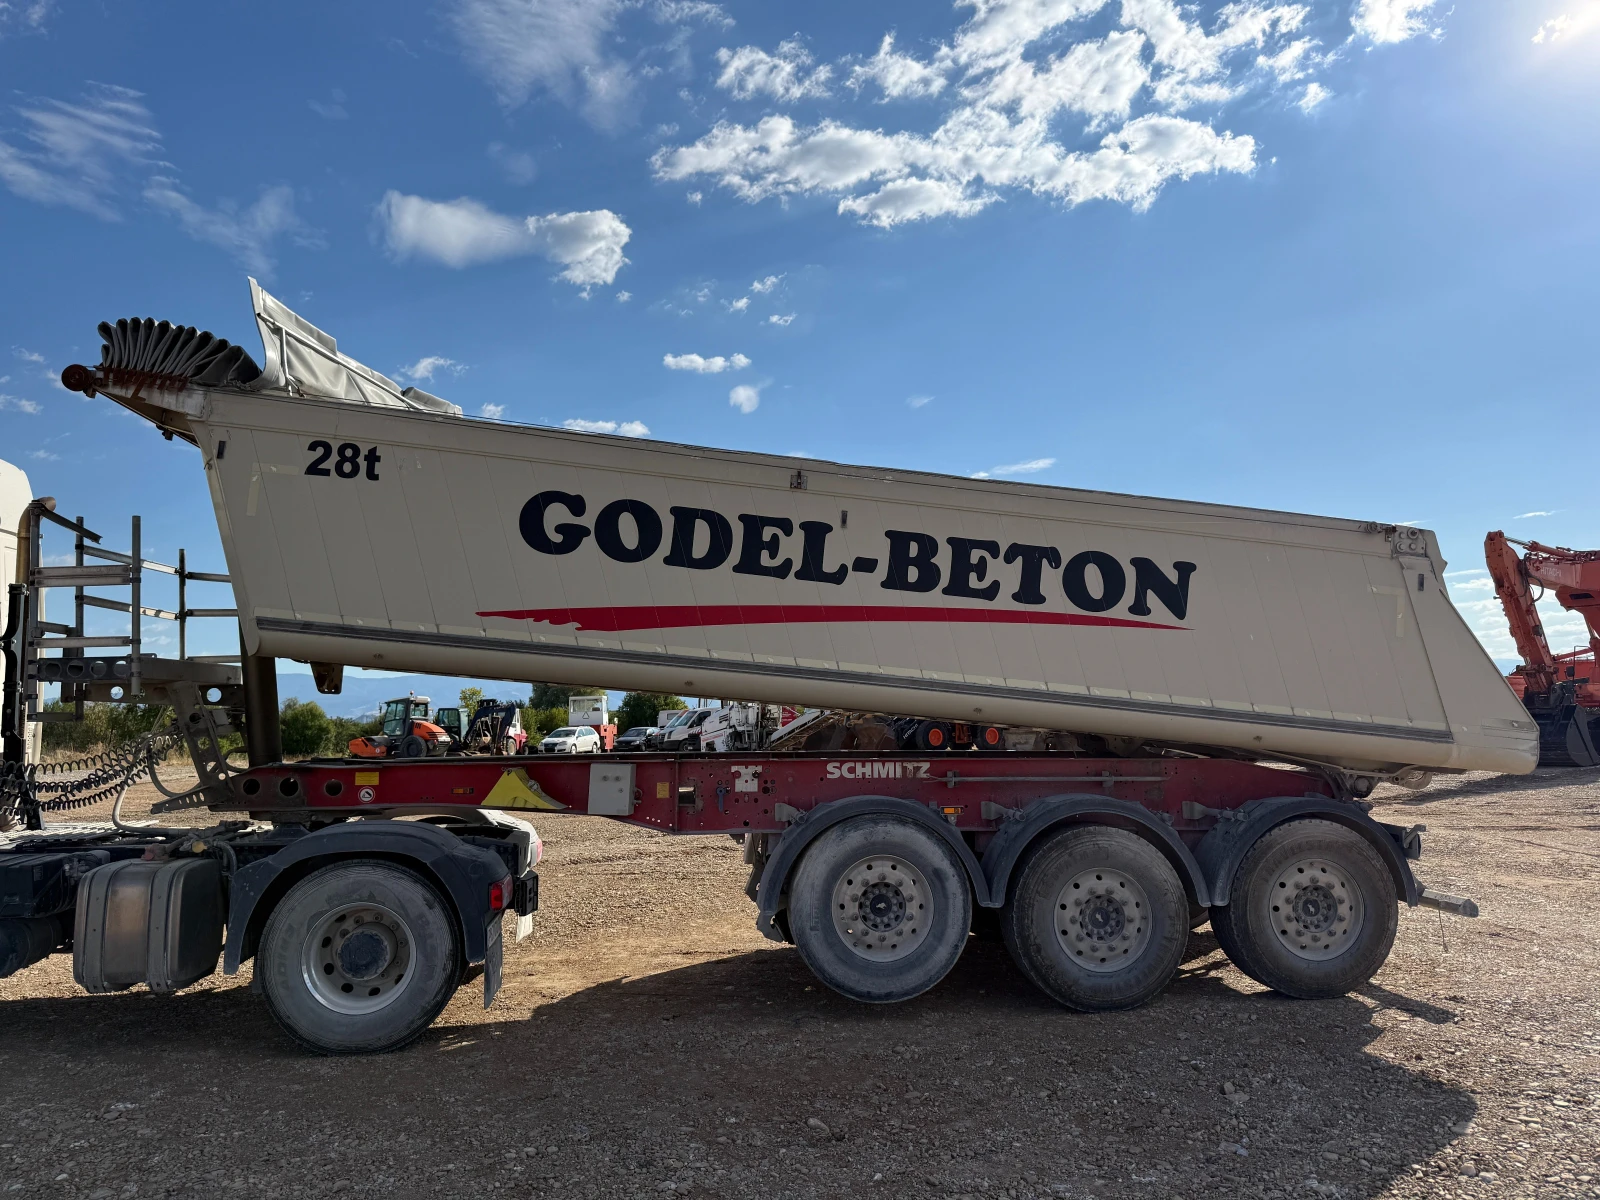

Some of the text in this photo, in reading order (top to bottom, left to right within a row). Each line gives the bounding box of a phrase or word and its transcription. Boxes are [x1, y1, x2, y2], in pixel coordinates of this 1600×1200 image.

[304, 440, 381, 481] 28t
[518, 490, 1197, 621] GODEL-BETON
[1540, 566, 1562, 577] HITACHI
[826, 761, 931, 779] SCHMITZ
